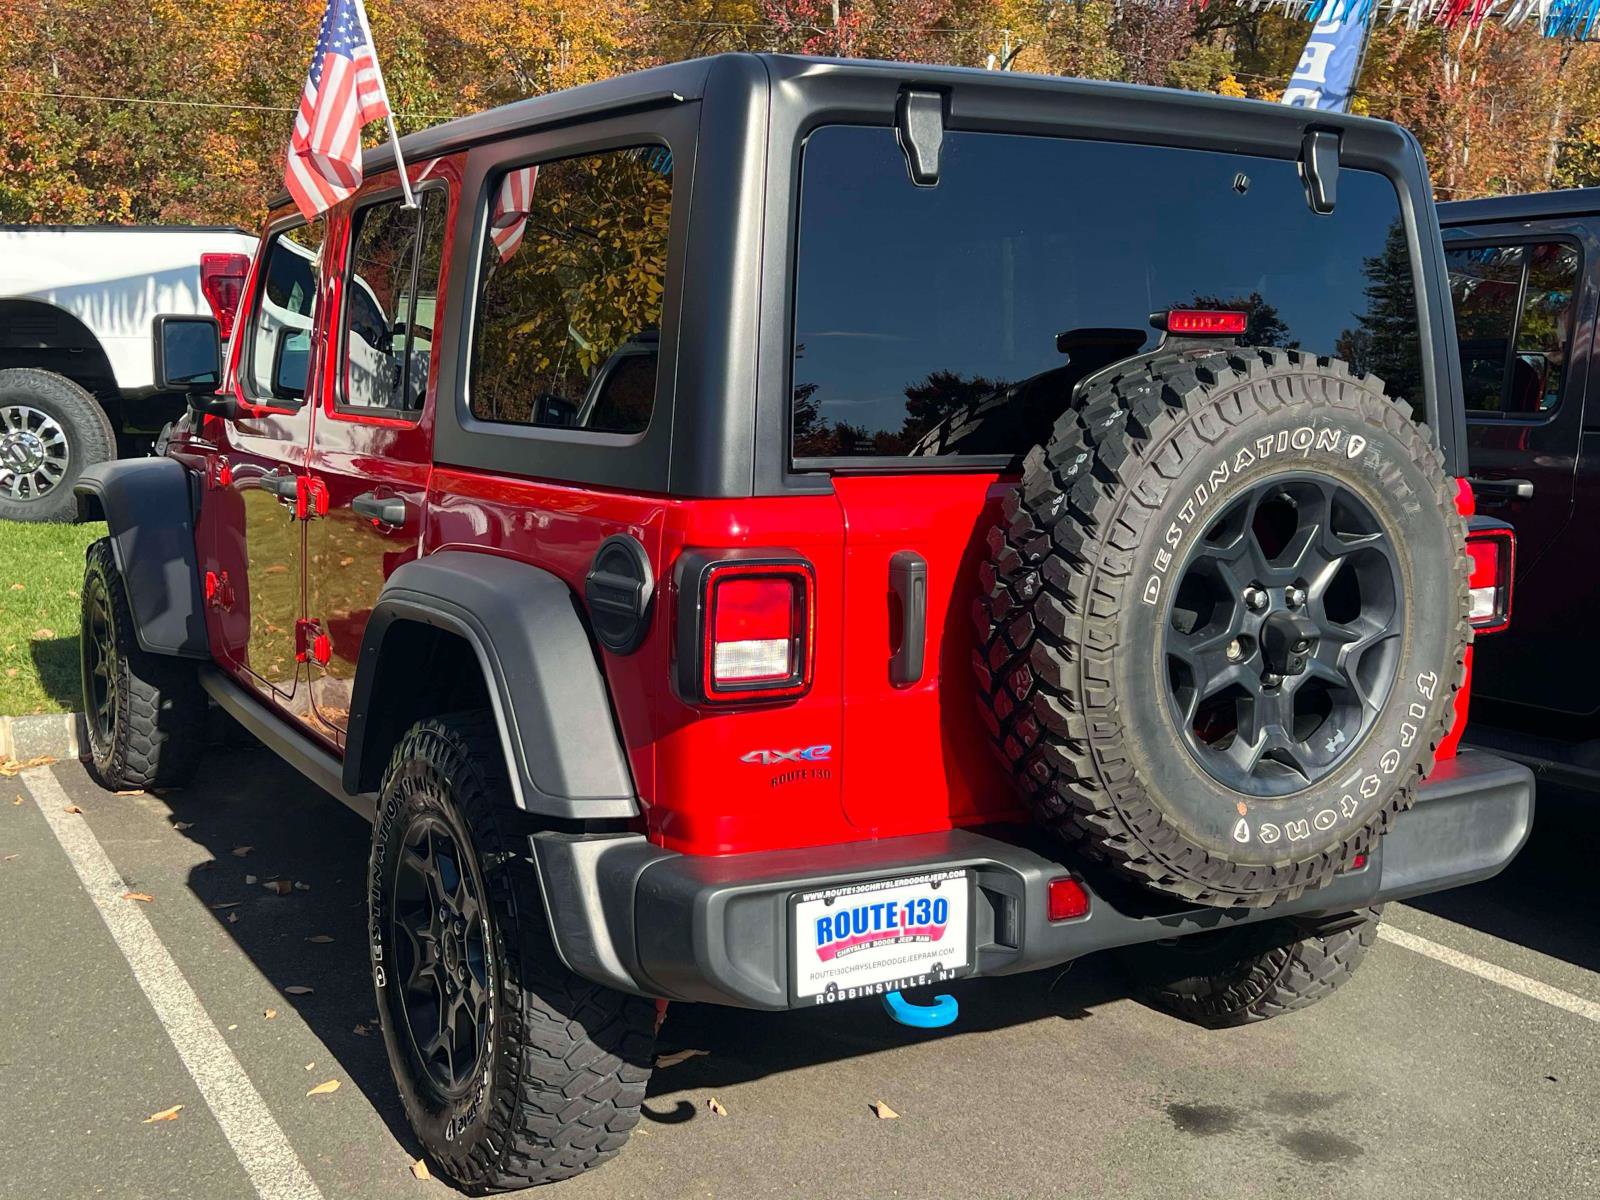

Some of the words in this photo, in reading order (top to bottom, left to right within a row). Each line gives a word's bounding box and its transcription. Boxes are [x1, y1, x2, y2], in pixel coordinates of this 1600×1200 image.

[1143, 426, 1341, 605] DESTINATION
[1258, 671, 1438, 845] Firestone
[771, 768, 807, 788] ROUTE
[811, 767, 831, 779] 130
[371, 791, 405, 988] DESTINATION
[803, 869, 966, 902] WWW.ROUTE130CHRYSLERDODGEJEEP.COM
[816, 901, 898, 946] ROUTE
[904, 897, 948, 925] 130
[809, 947, 955, 981] ROUTE130CHRYSLERDODGEJEEPRAM.COM
[836, 942, 871, 957] CHRYSLER
[873, 937, 895, 948] DODGE
[898, 935, 914, 944] JEEP
[915, 935, 930, 943] RAM
[815, 974, 932, 1005] ROBBINSVILLE,
[939, 969, 956, 981] NJ
